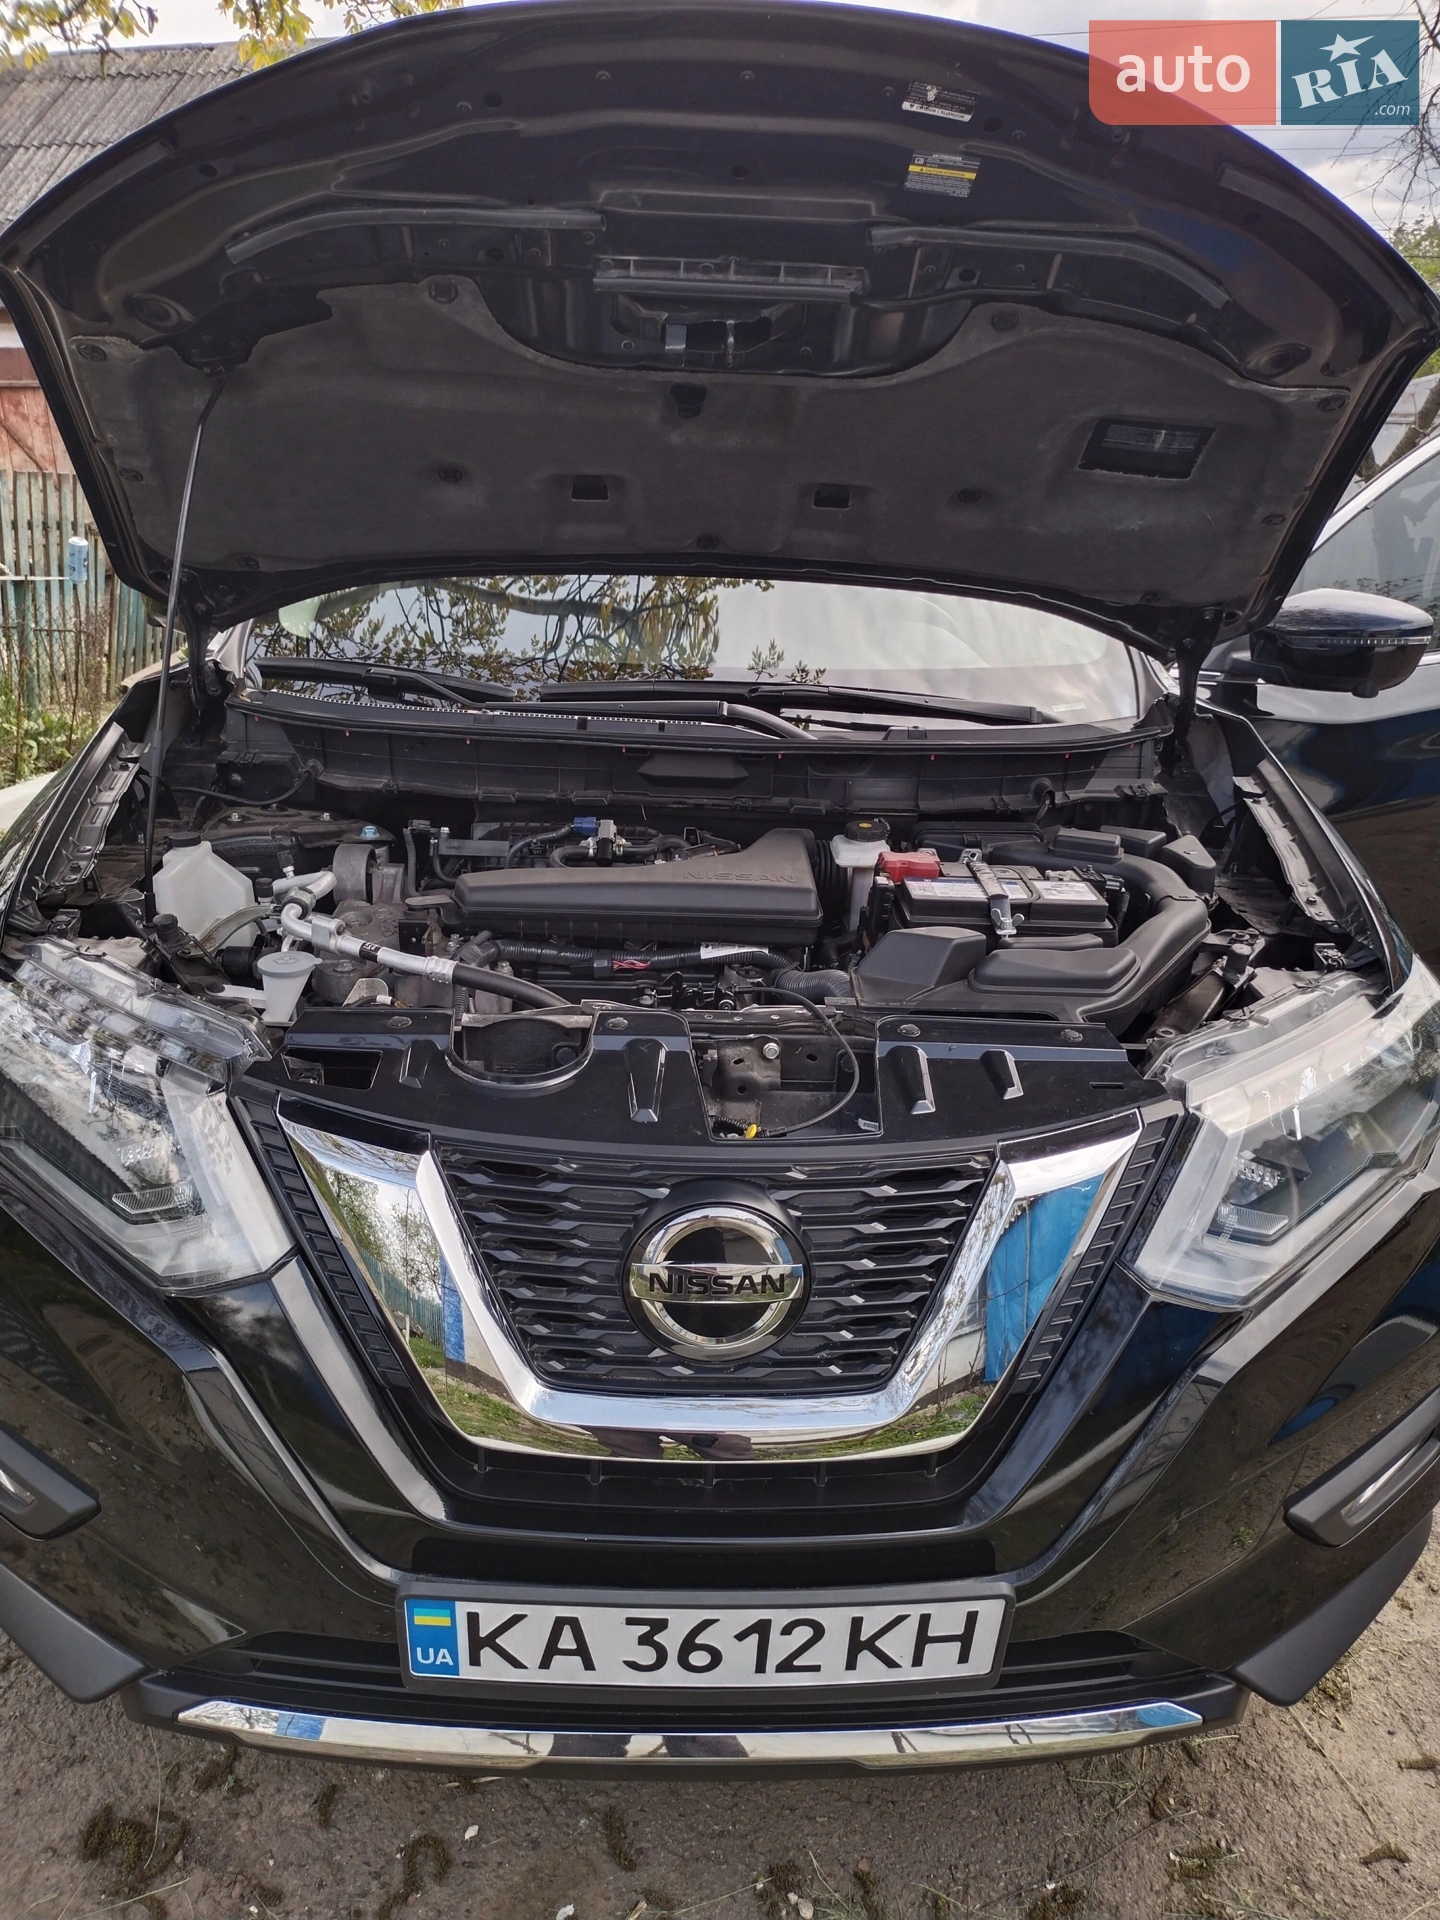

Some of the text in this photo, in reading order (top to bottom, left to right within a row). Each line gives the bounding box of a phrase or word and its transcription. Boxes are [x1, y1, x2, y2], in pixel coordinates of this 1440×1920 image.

[683, 872, 797, 884] NISSAN
[649, 1273, 785, 1296] NISSAN
[466, 1610, 979, 1674] KA 3612 KH
[416, 1647, 454, 1666] UA
